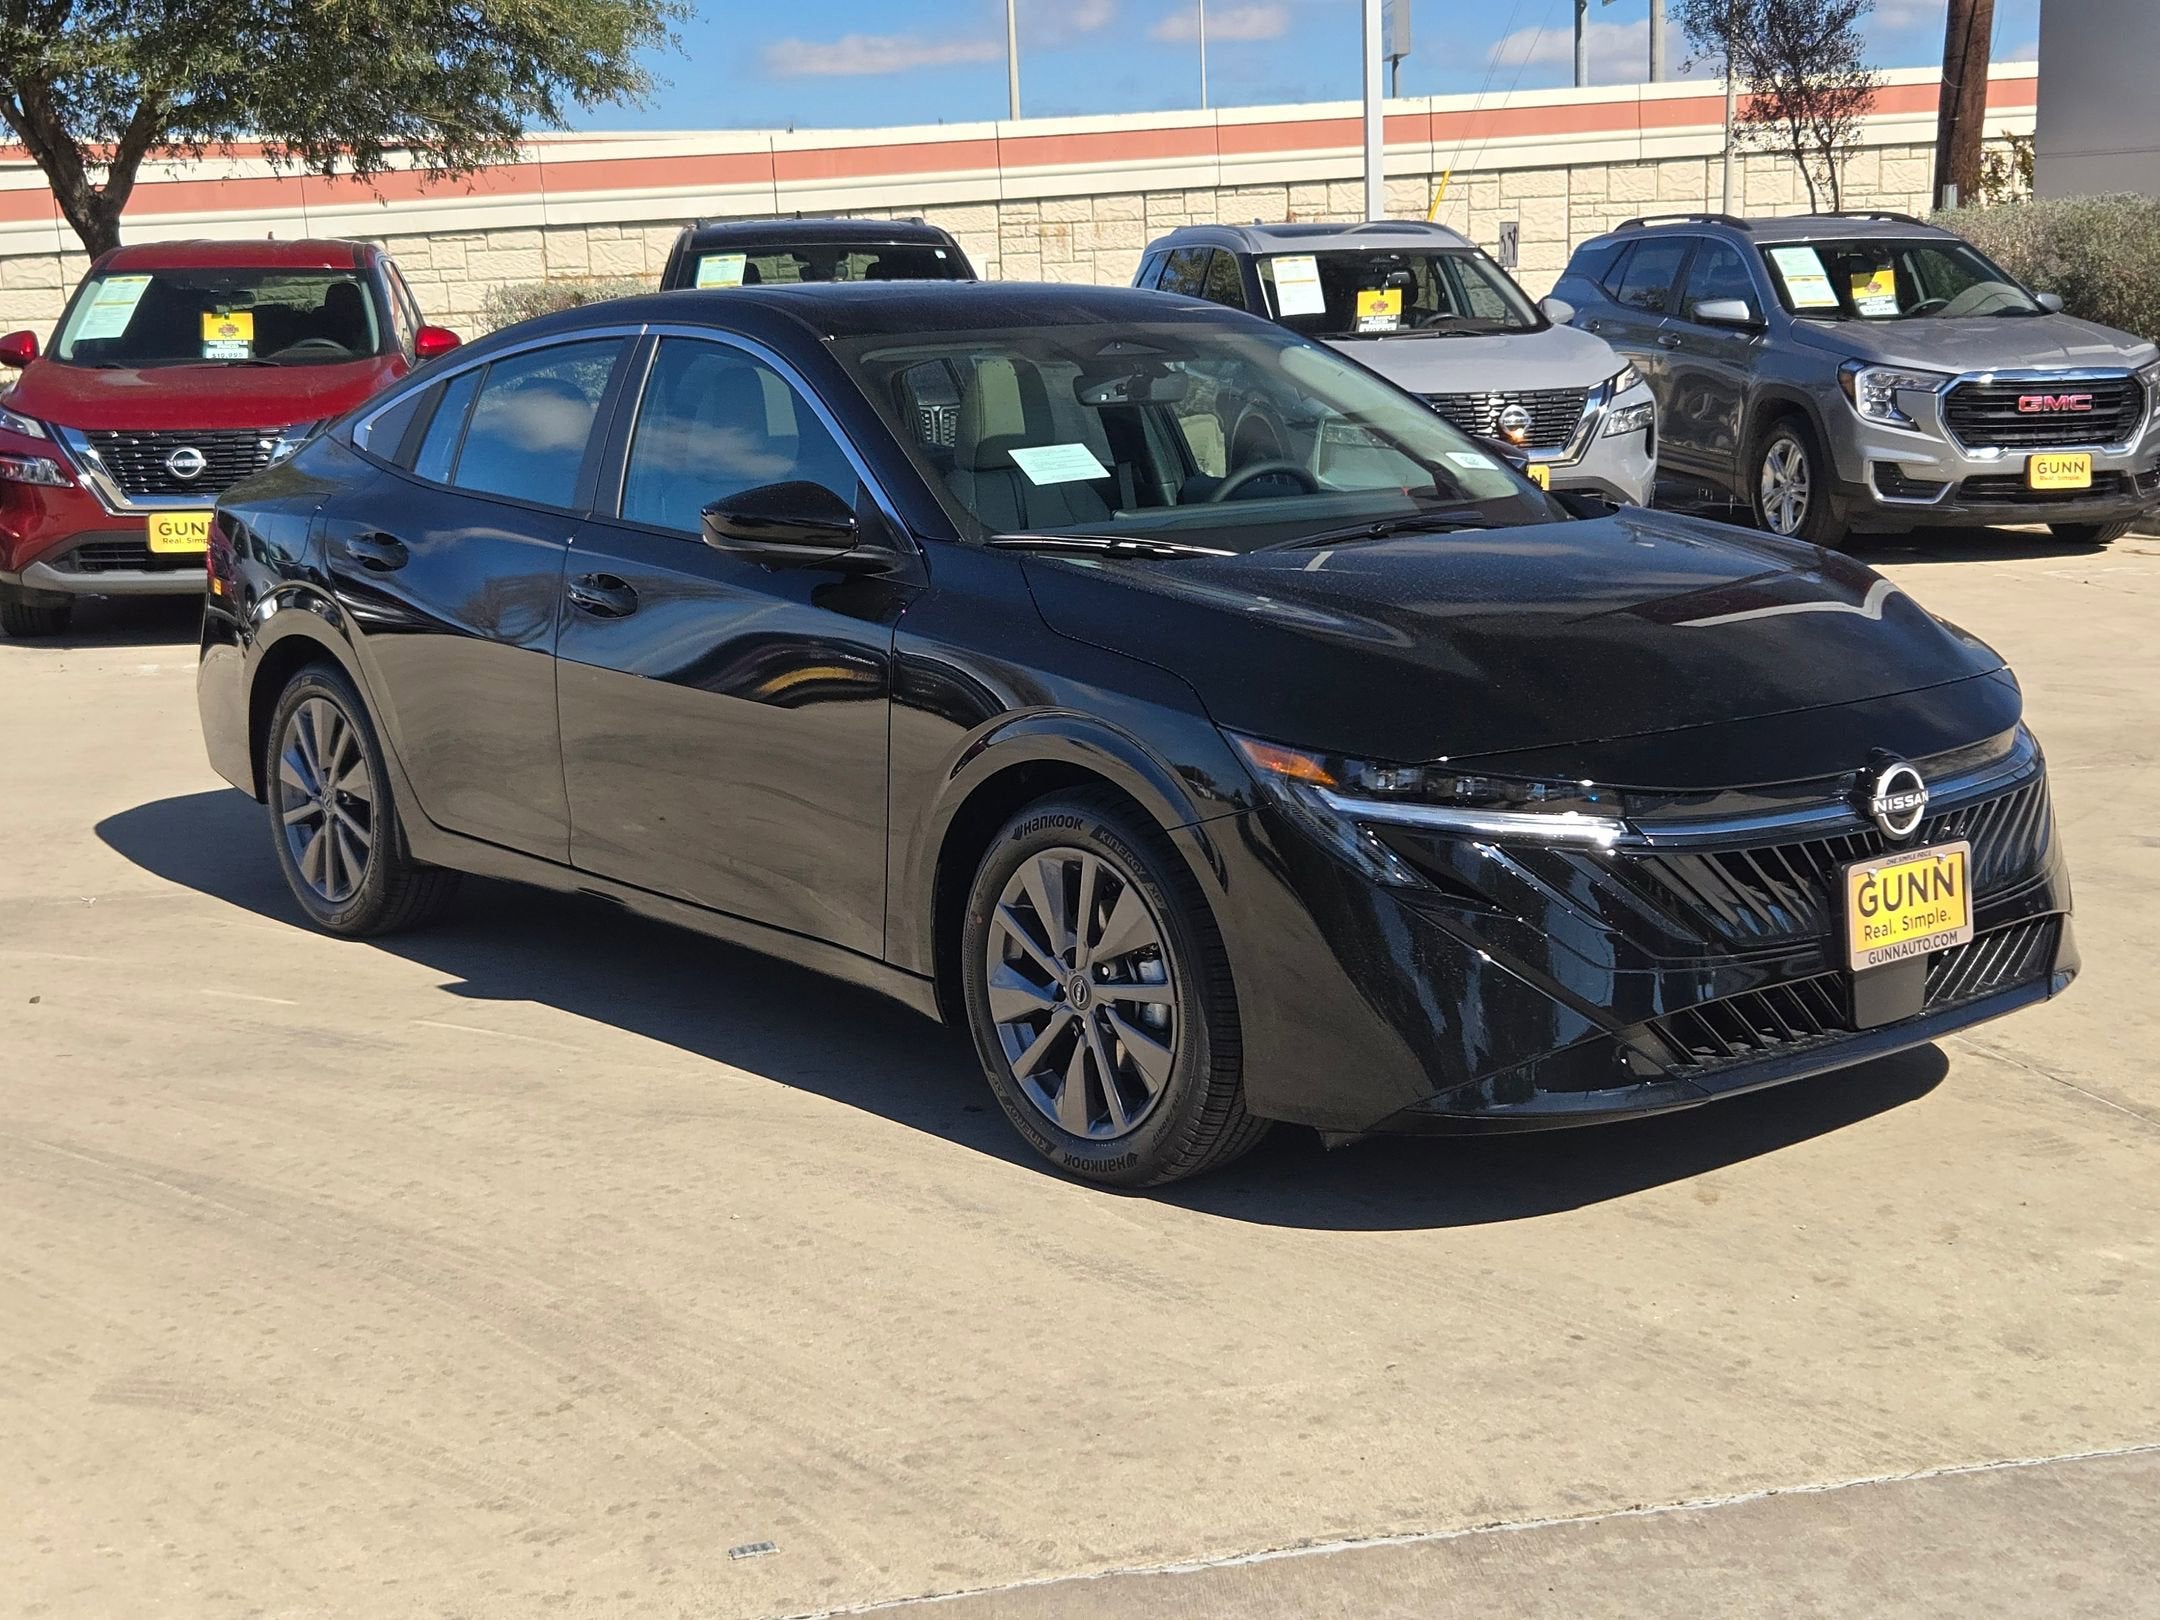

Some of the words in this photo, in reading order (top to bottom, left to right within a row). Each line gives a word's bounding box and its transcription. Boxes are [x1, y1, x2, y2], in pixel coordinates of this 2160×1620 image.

[2018, 394, 2093, 412] GMC
[2037, 461, 2085, 474] GUNN
[158, 521, 206, 536] GUN
[162, 537, 183, 545] Real.
[1873, 788, 1930, 814] NISSAN
[1858, 862, 1955, 918] GUNN
[1864, 918, 1897, 942] Real.
[1902, 907, 1952, 932] Simple.
[1868, 930, 1958, 965] GUNNAUTO.COM
